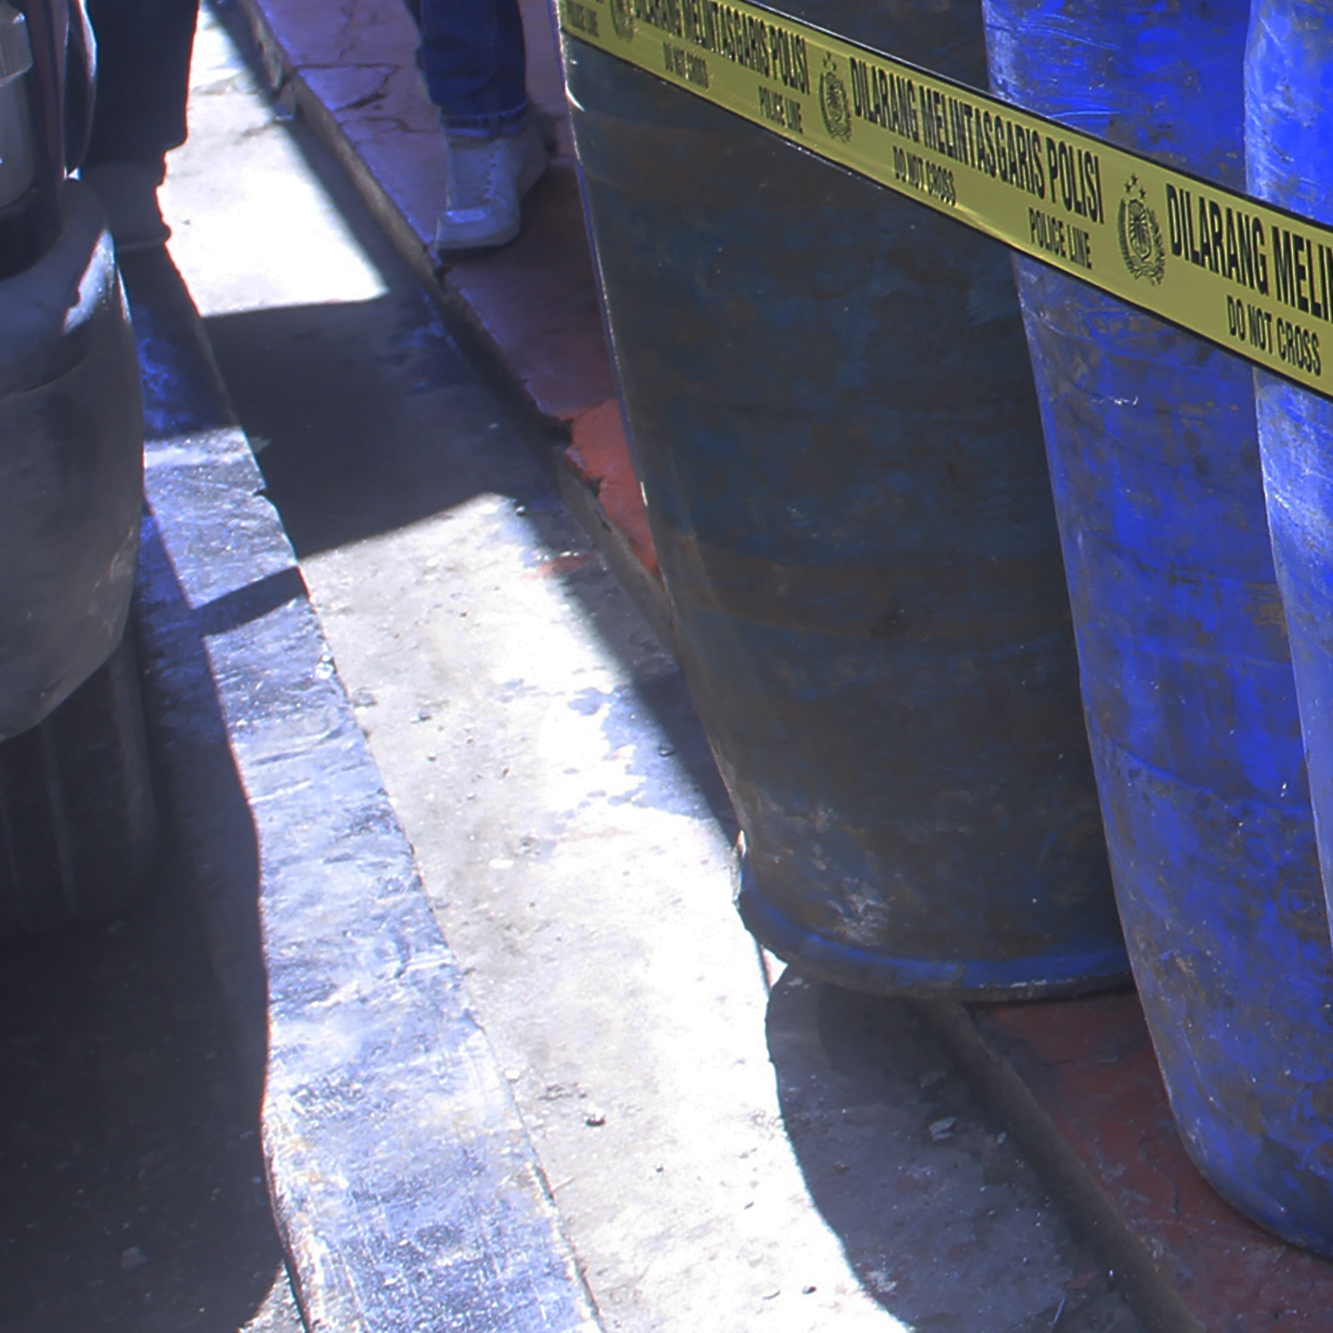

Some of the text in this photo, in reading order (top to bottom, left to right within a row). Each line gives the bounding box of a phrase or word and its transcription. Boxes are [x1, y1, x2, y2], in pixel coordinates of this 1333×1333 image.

[850, 57, 920, 143] DILARANG
[1046, 137, 1104, 224] POLISI
[1028, 207, 1092, 269] POLICE LINE
[1166, 183, 1269, 297] DILARANG
[1226, 294, 1322, 377] DO NOT CROSS
